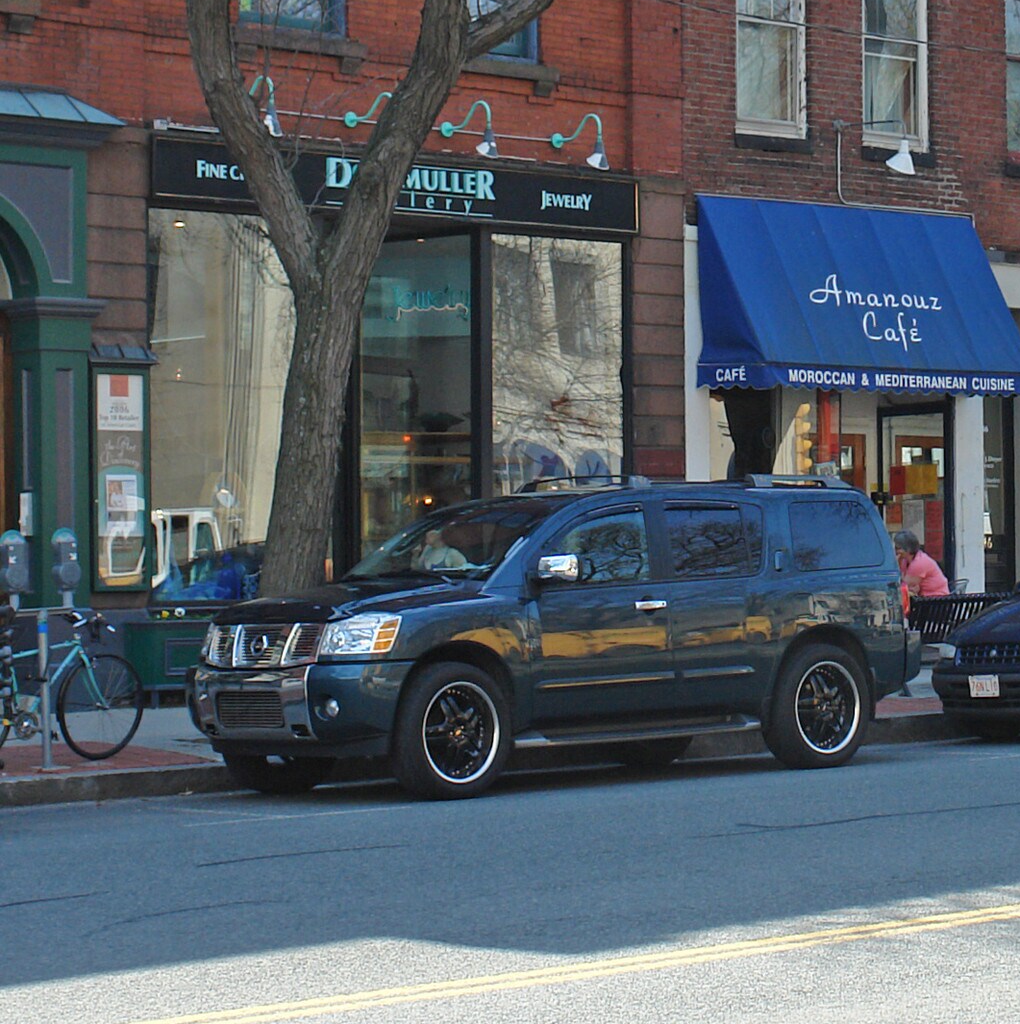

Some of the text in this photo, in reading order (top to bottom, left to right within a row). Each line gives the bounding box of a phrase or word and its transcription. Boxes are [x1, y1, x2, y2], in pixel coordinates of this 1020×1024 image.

[196, 160, 227, 179] FINE
[540, 190, 592, 211] JEWELRY
[809, 274, 942, 310] Amanouz
[862, 311, 922, 352] Café
[715, 365, 747, 383] CAFÉ
[788, 369, 1016, 392] MOROCCAN & MEDITERRANEAN CUISINE
